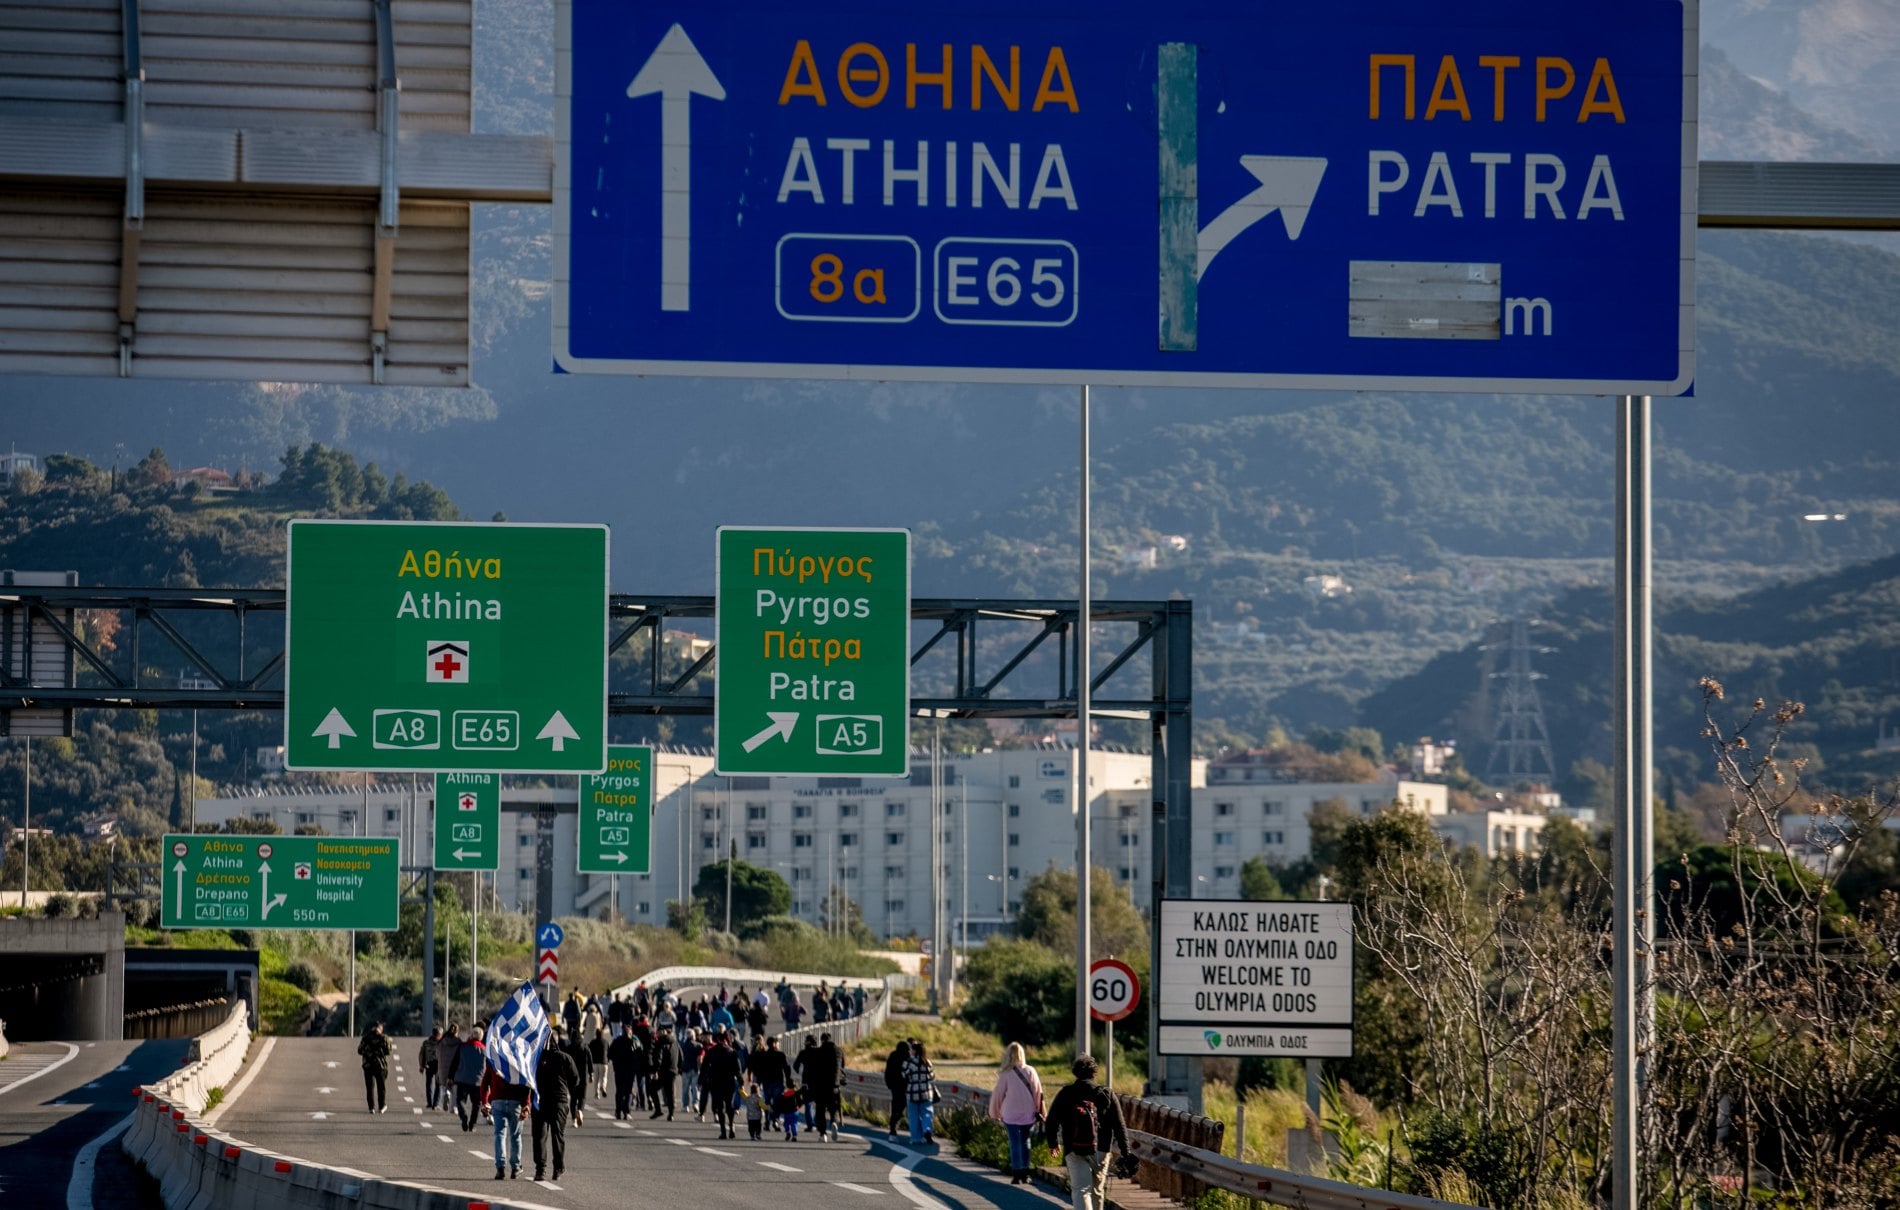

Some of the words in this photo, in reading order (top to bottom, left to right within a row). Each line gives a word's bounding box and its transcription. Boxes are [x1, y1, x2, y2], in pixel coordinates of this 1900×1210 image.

[779, 40, 1079, 112] ΑΘΗΝΑ
[1369, 54, 1625, 123] ΠΑΤΡΑ
[777, 137, 1078, 210] ATHINA
[1369, 150, 1624, 220] PATRA
[948, 257, 1064, 307] E65
[1505, 298, 1552, 335] m
[399, 550, 500, 578] Αθήνα
[754, 548, 872, 583] Πύργος
[397, 591, 501, 620] Athina
[757, 590, 869, 625] Pyrgos
[765, 631, 860, 666] Πάτρα
[771, 673, 854, 700] Patra
[390, 718, 424, 741] A8
[462, 719, 509, 742] E65
[833, 723, 866, 746] A5
[609, 759, 640, 771] ργος
[446, 773, 490, 784] Athina
[591, 775, 640, 789] Pyrgos
[594, 791, 637, 806] Πάτρα
[597, 809, 633, 822] Patra
[460, 828, 475, 839] A8
[607, 831, 622, 842] A5
[204, 841, 243, 852] Αθήνα
[203, 856, 243, 868] Athina
[317, 874, 363, 887] University
[196, 888, 248, 902] Drepano
[317, 890, 353, 903] Hospital
[202, 906, 215, 917] A8
[225, 906, 245, 917] E65
[294, 909, 315, 921] 550
[318, 913, 328, 921] m
[1193, 911, 1249, 933] ΚΑΛΩΣ
[1256, 912, 1320, 934] ΗΛΘΑΤΕ
[1175, 937, 1218, 959] ΣΤΗΝ
[1224, 939, 1299, 961] ΟΛΥΜΠΙΑ
[1304, 940, 1338, 961] ΟΔΟ
[1201, 964, 1284, 987] WELCOME
[1290, 966, 1312, 987] TO
[1091, 977, 1127, 1003] 60
[1194, 991, 1266, 1013] OLYMPIA
[1272, 993, 1317, 1013] ODOS
[1225, 1033, 1275, 1049] ΟΛΥΜΠΙΑ
[1279, 1034, 1308, 1049] ΟΔΟΣ
